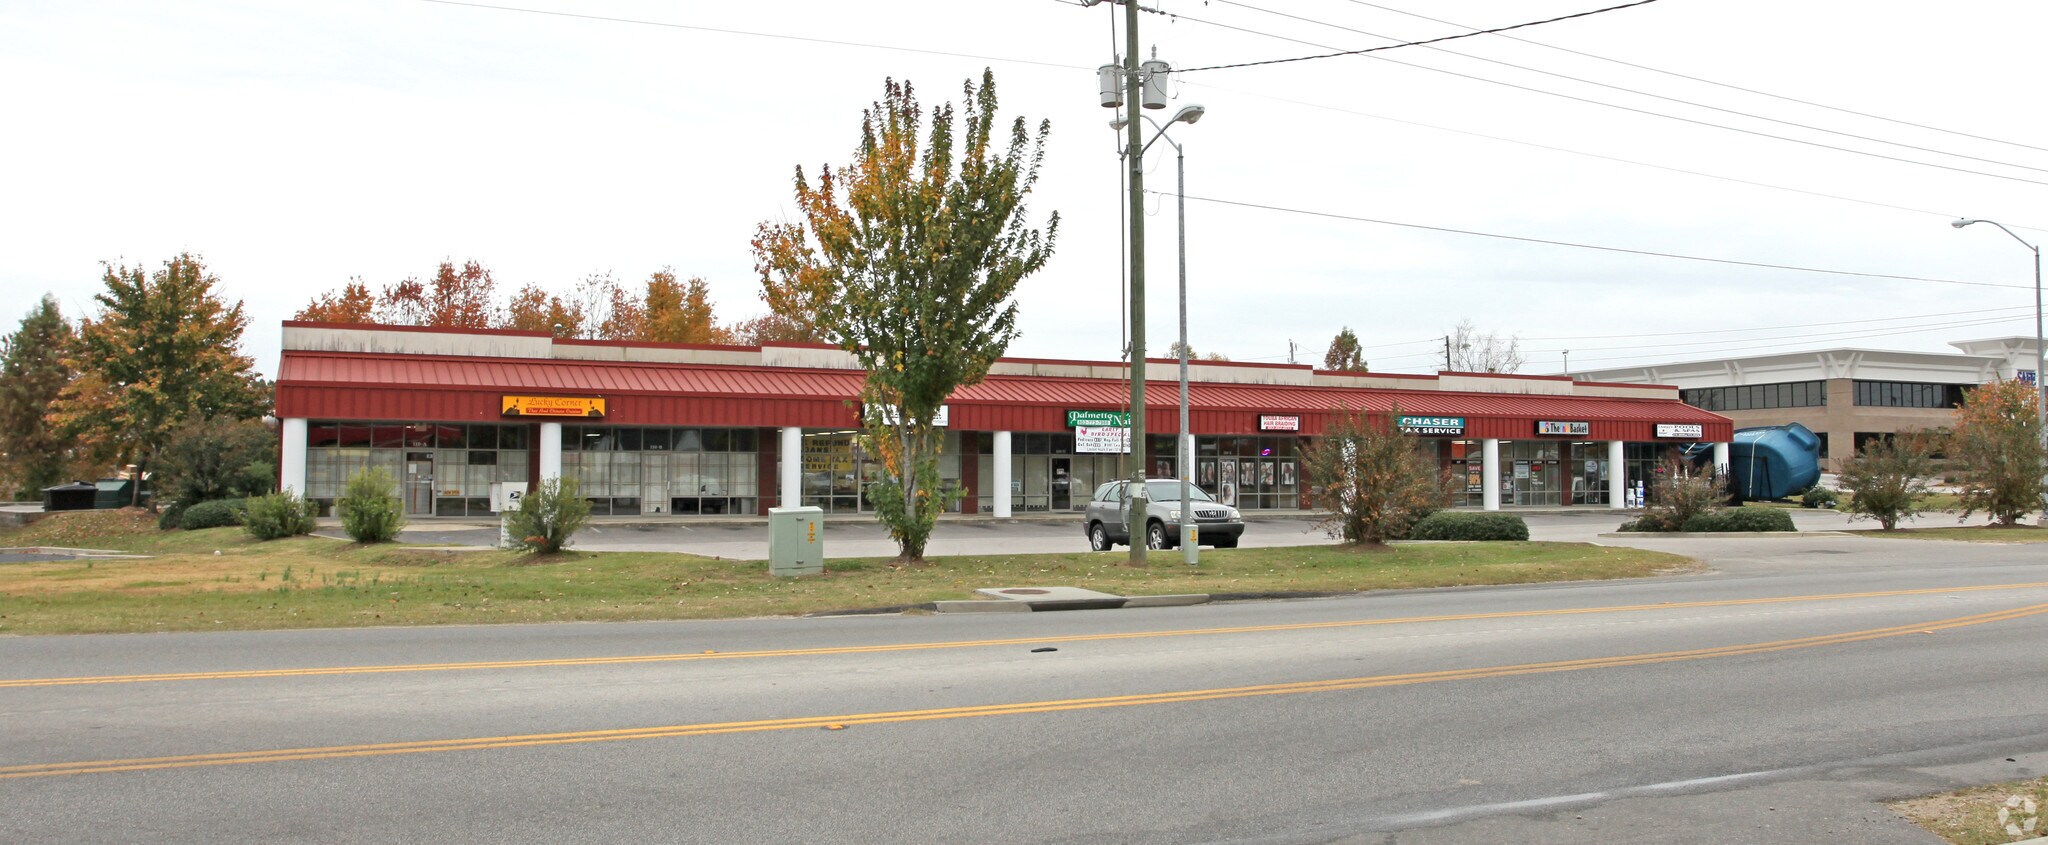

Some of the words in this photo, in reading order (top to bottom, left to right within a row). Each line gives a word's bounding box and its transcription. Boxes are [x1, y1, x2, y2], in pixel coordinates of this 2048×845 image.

[527, 398, 553, 407] Lucky
[555, 398, 582, 407] Corner
[1069, 411, 1113, 424] Palmetto
[1112, 413, 1131, 426] Nai
[1402, 417, 1459, 426] CHASER
[1550, 422, 1560, 433] The
[1570, 423, 1587, 433] Basket
